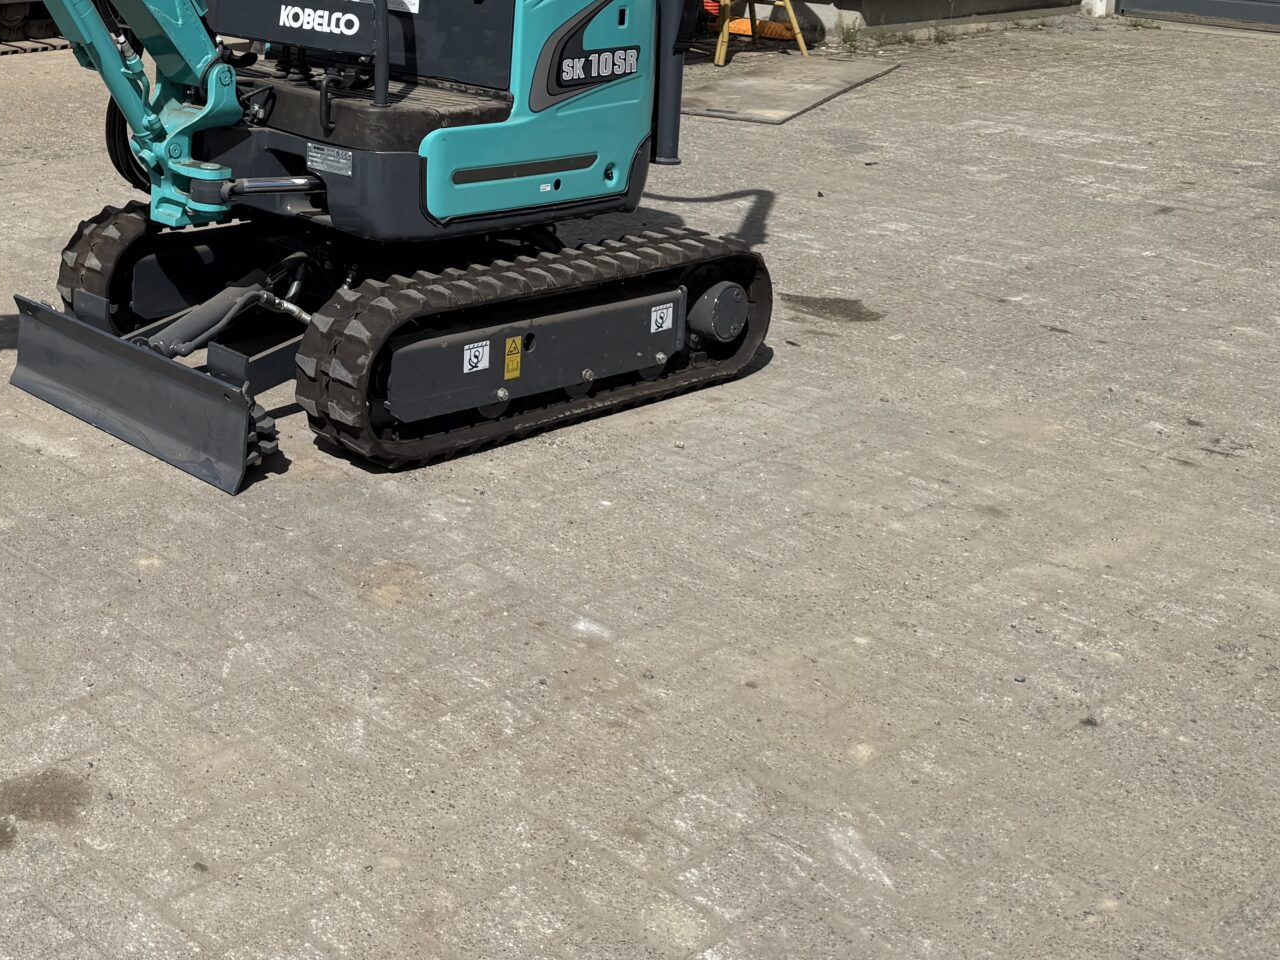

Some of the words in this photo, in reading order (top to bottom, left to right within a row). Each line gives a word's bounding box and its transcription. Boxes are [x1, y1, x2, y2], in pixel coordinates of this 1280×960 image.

[279, 4, 360, 36] KOBELCO
[562, 57, 586, 81] SK
[588, 49, 638, 77] 10SR
